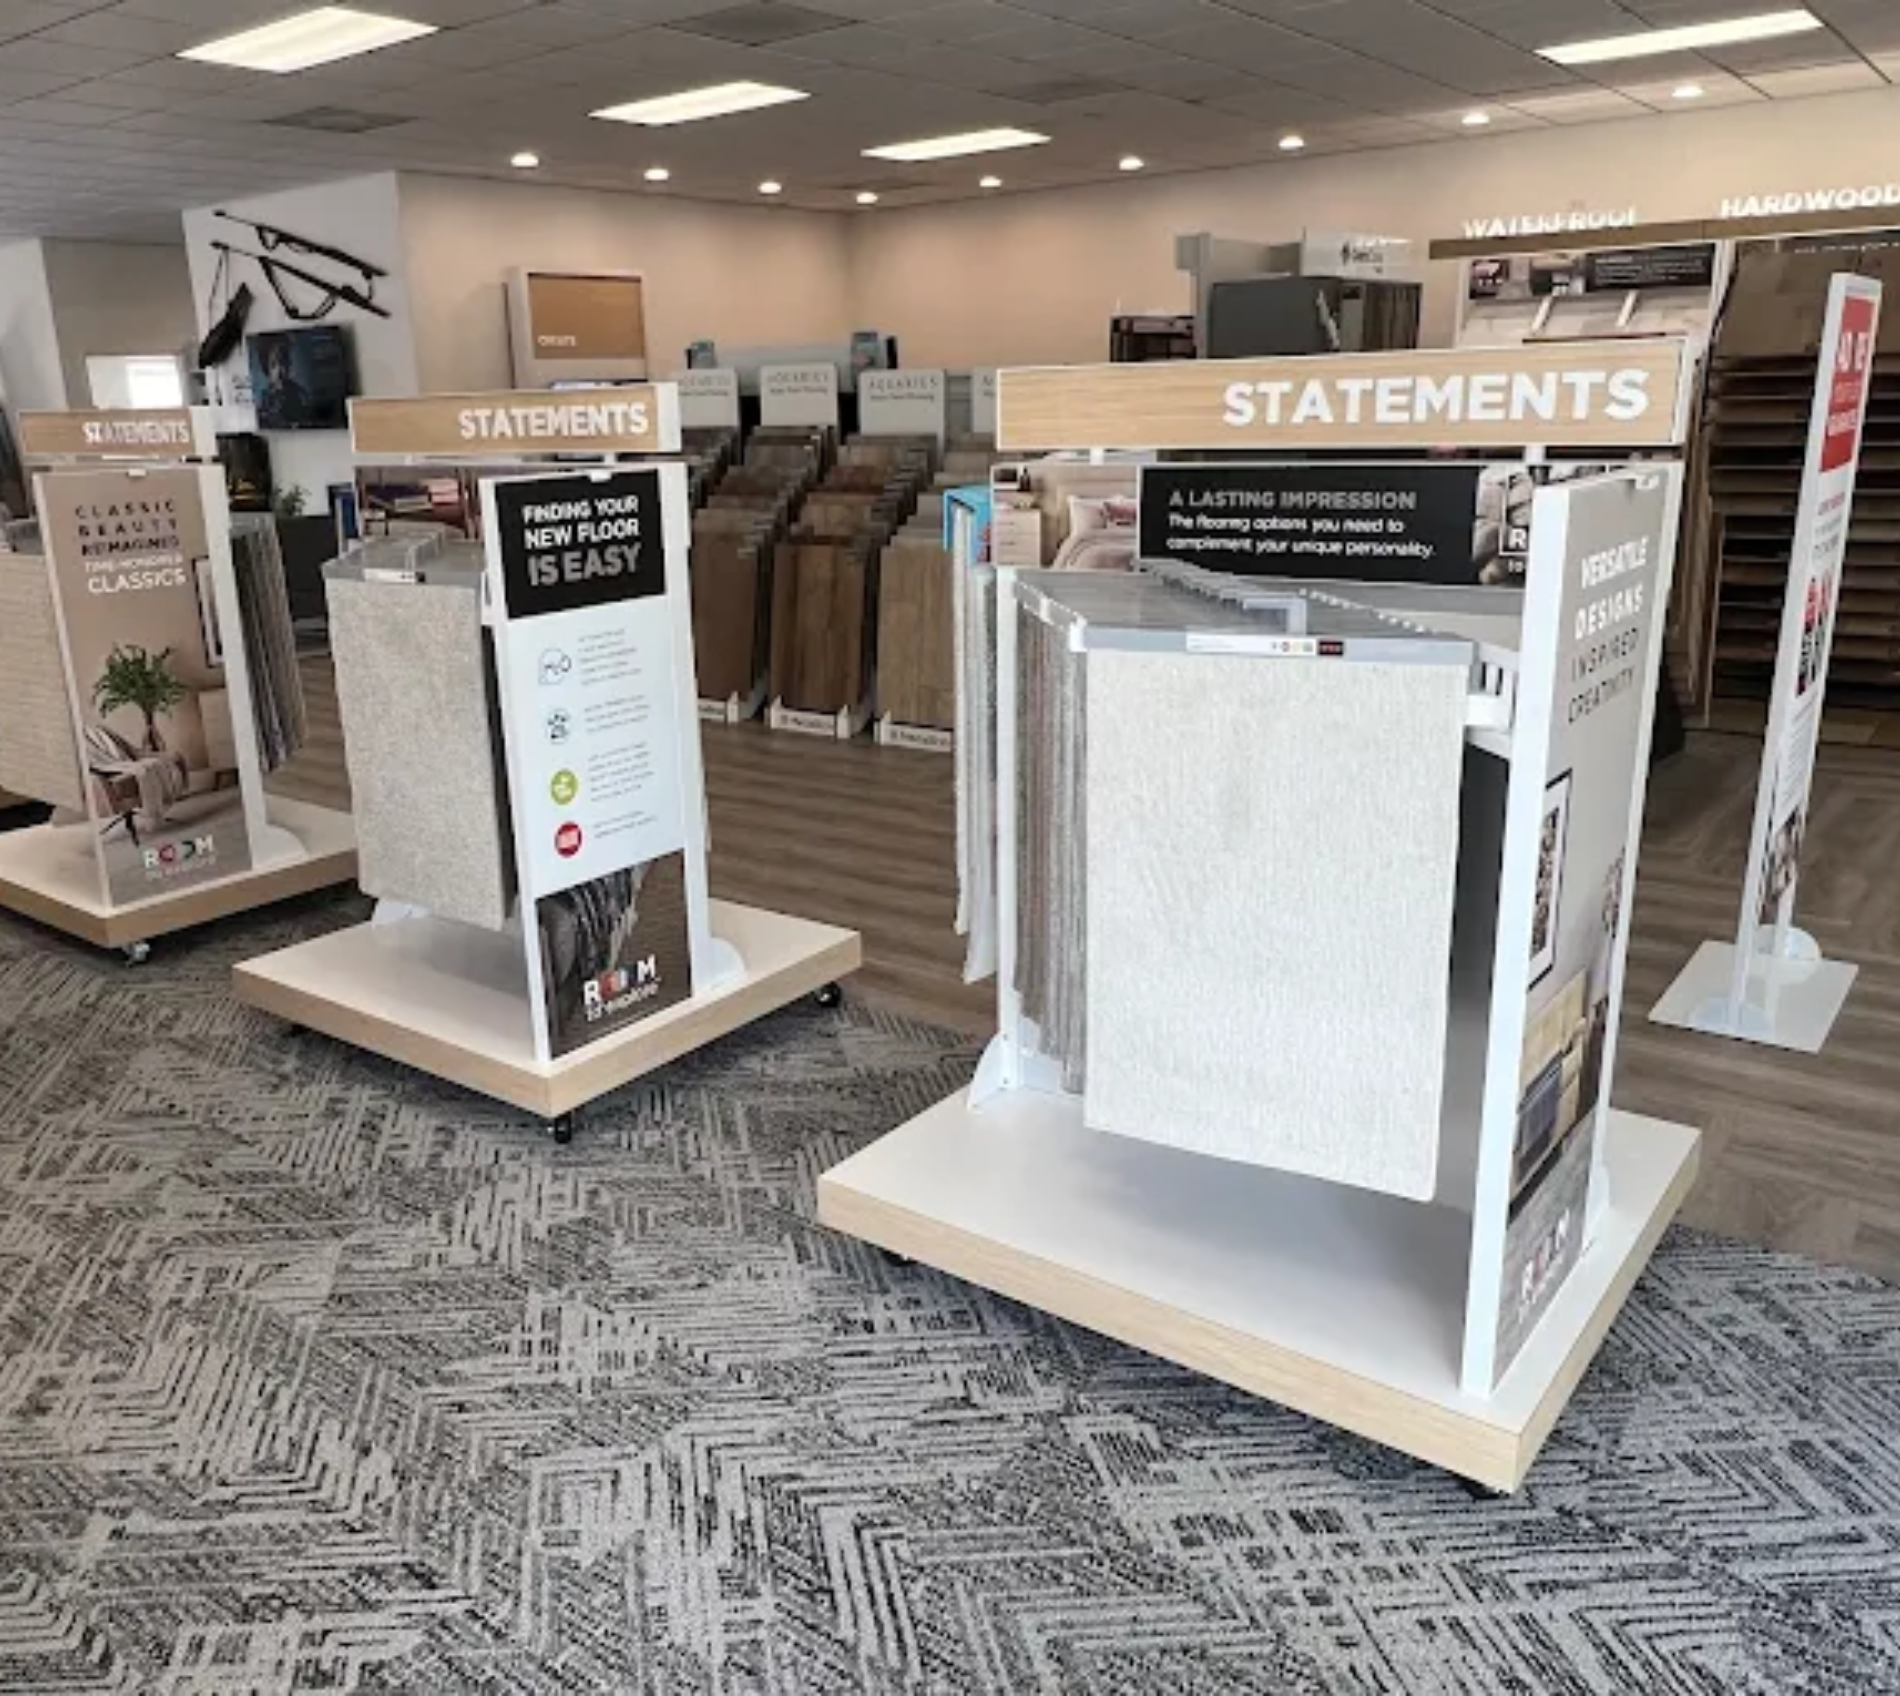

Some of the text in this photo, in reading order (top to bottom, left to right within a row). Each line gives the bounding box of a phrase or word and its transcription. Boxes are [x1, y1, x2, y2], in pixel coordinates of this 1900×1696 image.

[1720, 183, 1900, 220] HARDWOOD
[1222, 367, 1651, 427] STATEMENTS
[83, 420, 190, 443] STATEMENTS
[458, 402, 649, 440] STATEMENTS
[75, 500, 175, 520] CLASSIC
[522, 494, 640, 525] FINDING YOUR
[1168, 490, 1418, 510] A LASTING IMPRESSION
[78, 518, 177, 537] BEAUTY
[524, 518, 641, 550] NEW FLOOR
[1168, 511, 1405, 534] The flooring options you need to
[1166, 535, 1437, 560] complement your unique personality.
[1581, 536, 1649, 590] VERSATILE
[527, 542, 642, 587] IS EASY
[88, 567, 188, 594] CLASSICS
[1574, 584, 1644, 640] DESIGNS
